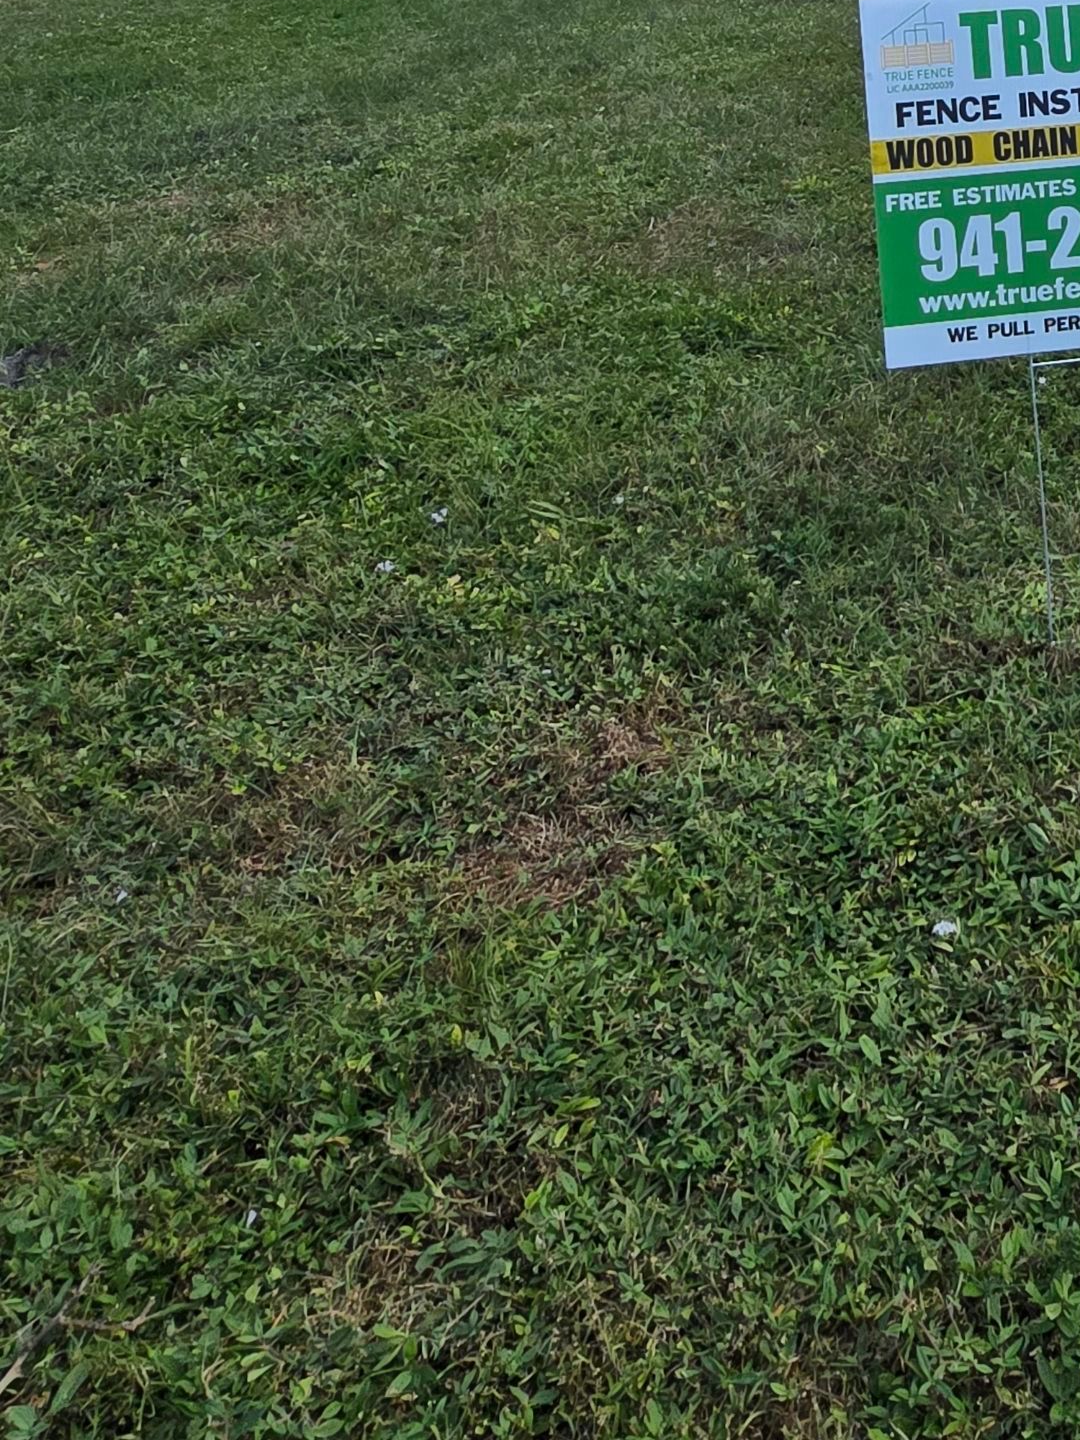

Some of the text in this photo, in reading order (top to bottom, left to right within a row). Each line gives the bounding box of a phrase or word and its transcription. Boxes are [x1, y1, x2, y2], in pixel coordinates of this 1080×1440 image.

[884, 67, 955, 82] TRUE FENCE
[895, 95, 1002, 128] FENCE
[886, 135, 974, 171] WOOD
[993, 126, 1078, 162] CHAIN
[885, 190, 942, 212] FREE
[952, 178, 1077, 206] ESTIMATES
[947, 325, 978, 343] WE
[987, 320, 1035, 339] PULL
